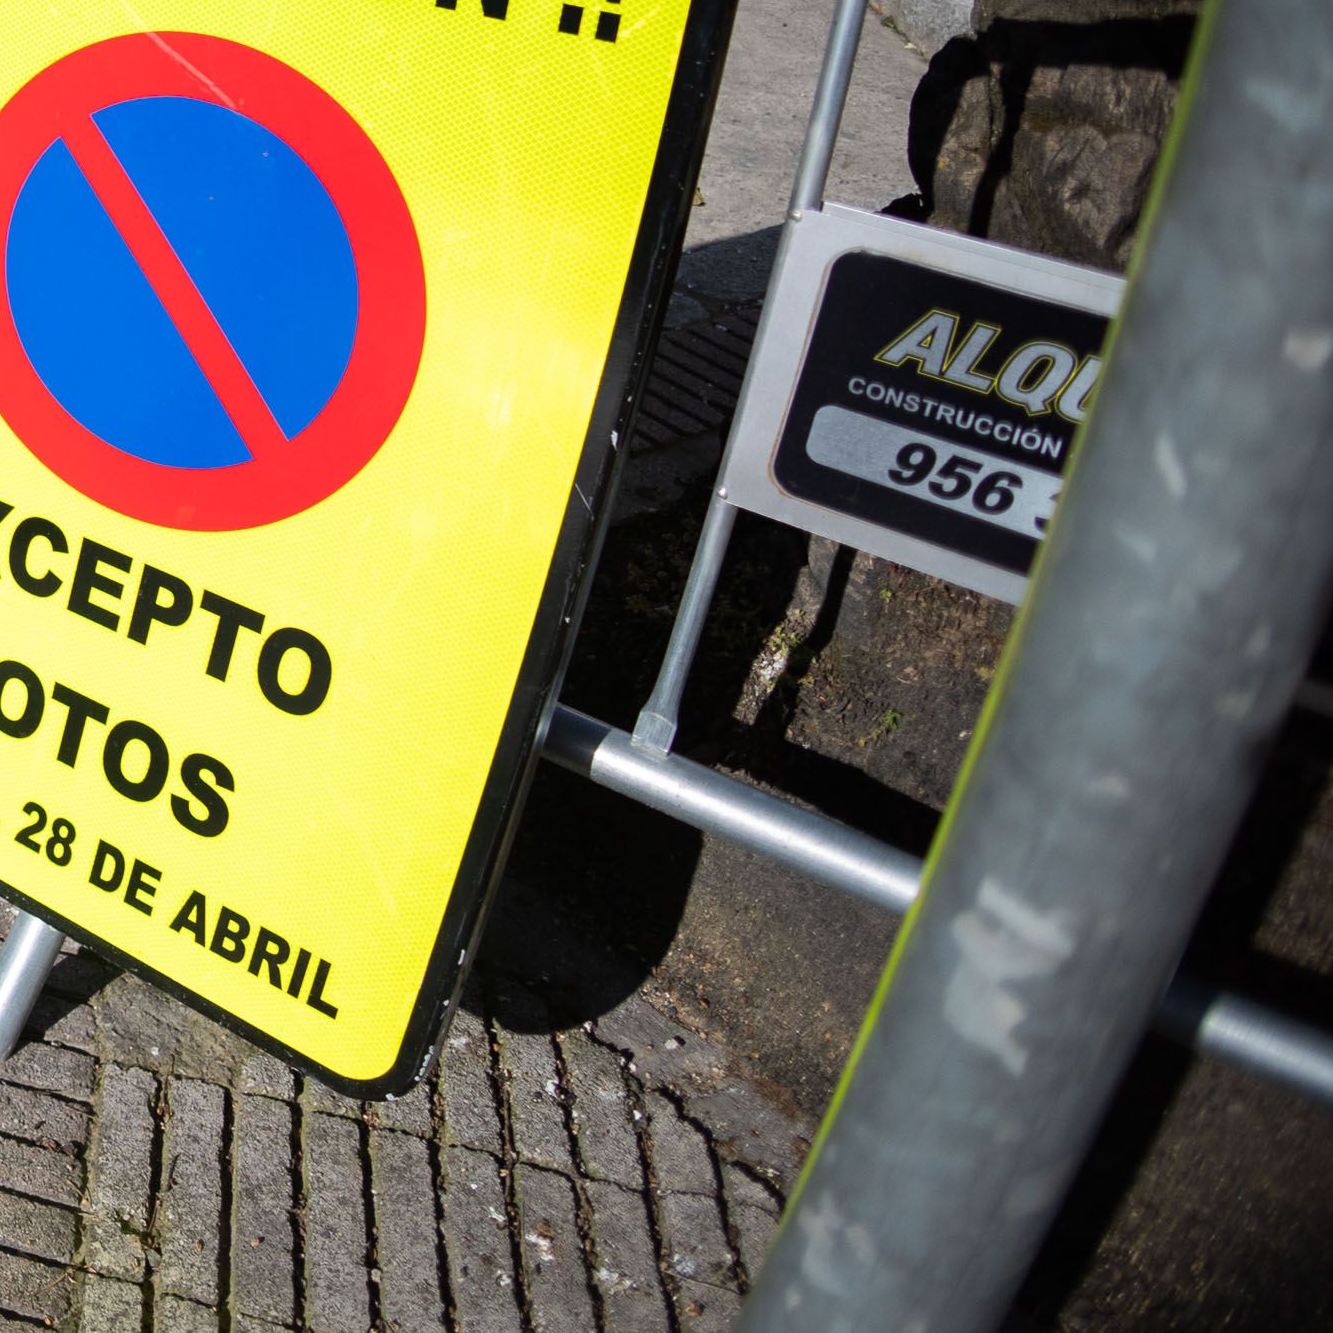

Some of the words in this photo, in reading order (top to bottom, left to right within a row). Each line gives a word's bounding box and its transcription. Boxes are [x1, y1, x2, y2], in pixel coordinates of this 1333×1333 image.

[847, 376, 1063, 459] CONSTRUCCIÓN
[887, 441, 1023, 516] 956
[14, 801, 76, 867] 28
[88, 839, 163, 916] DE
[169, 890, 338, 1020] ABRIL
